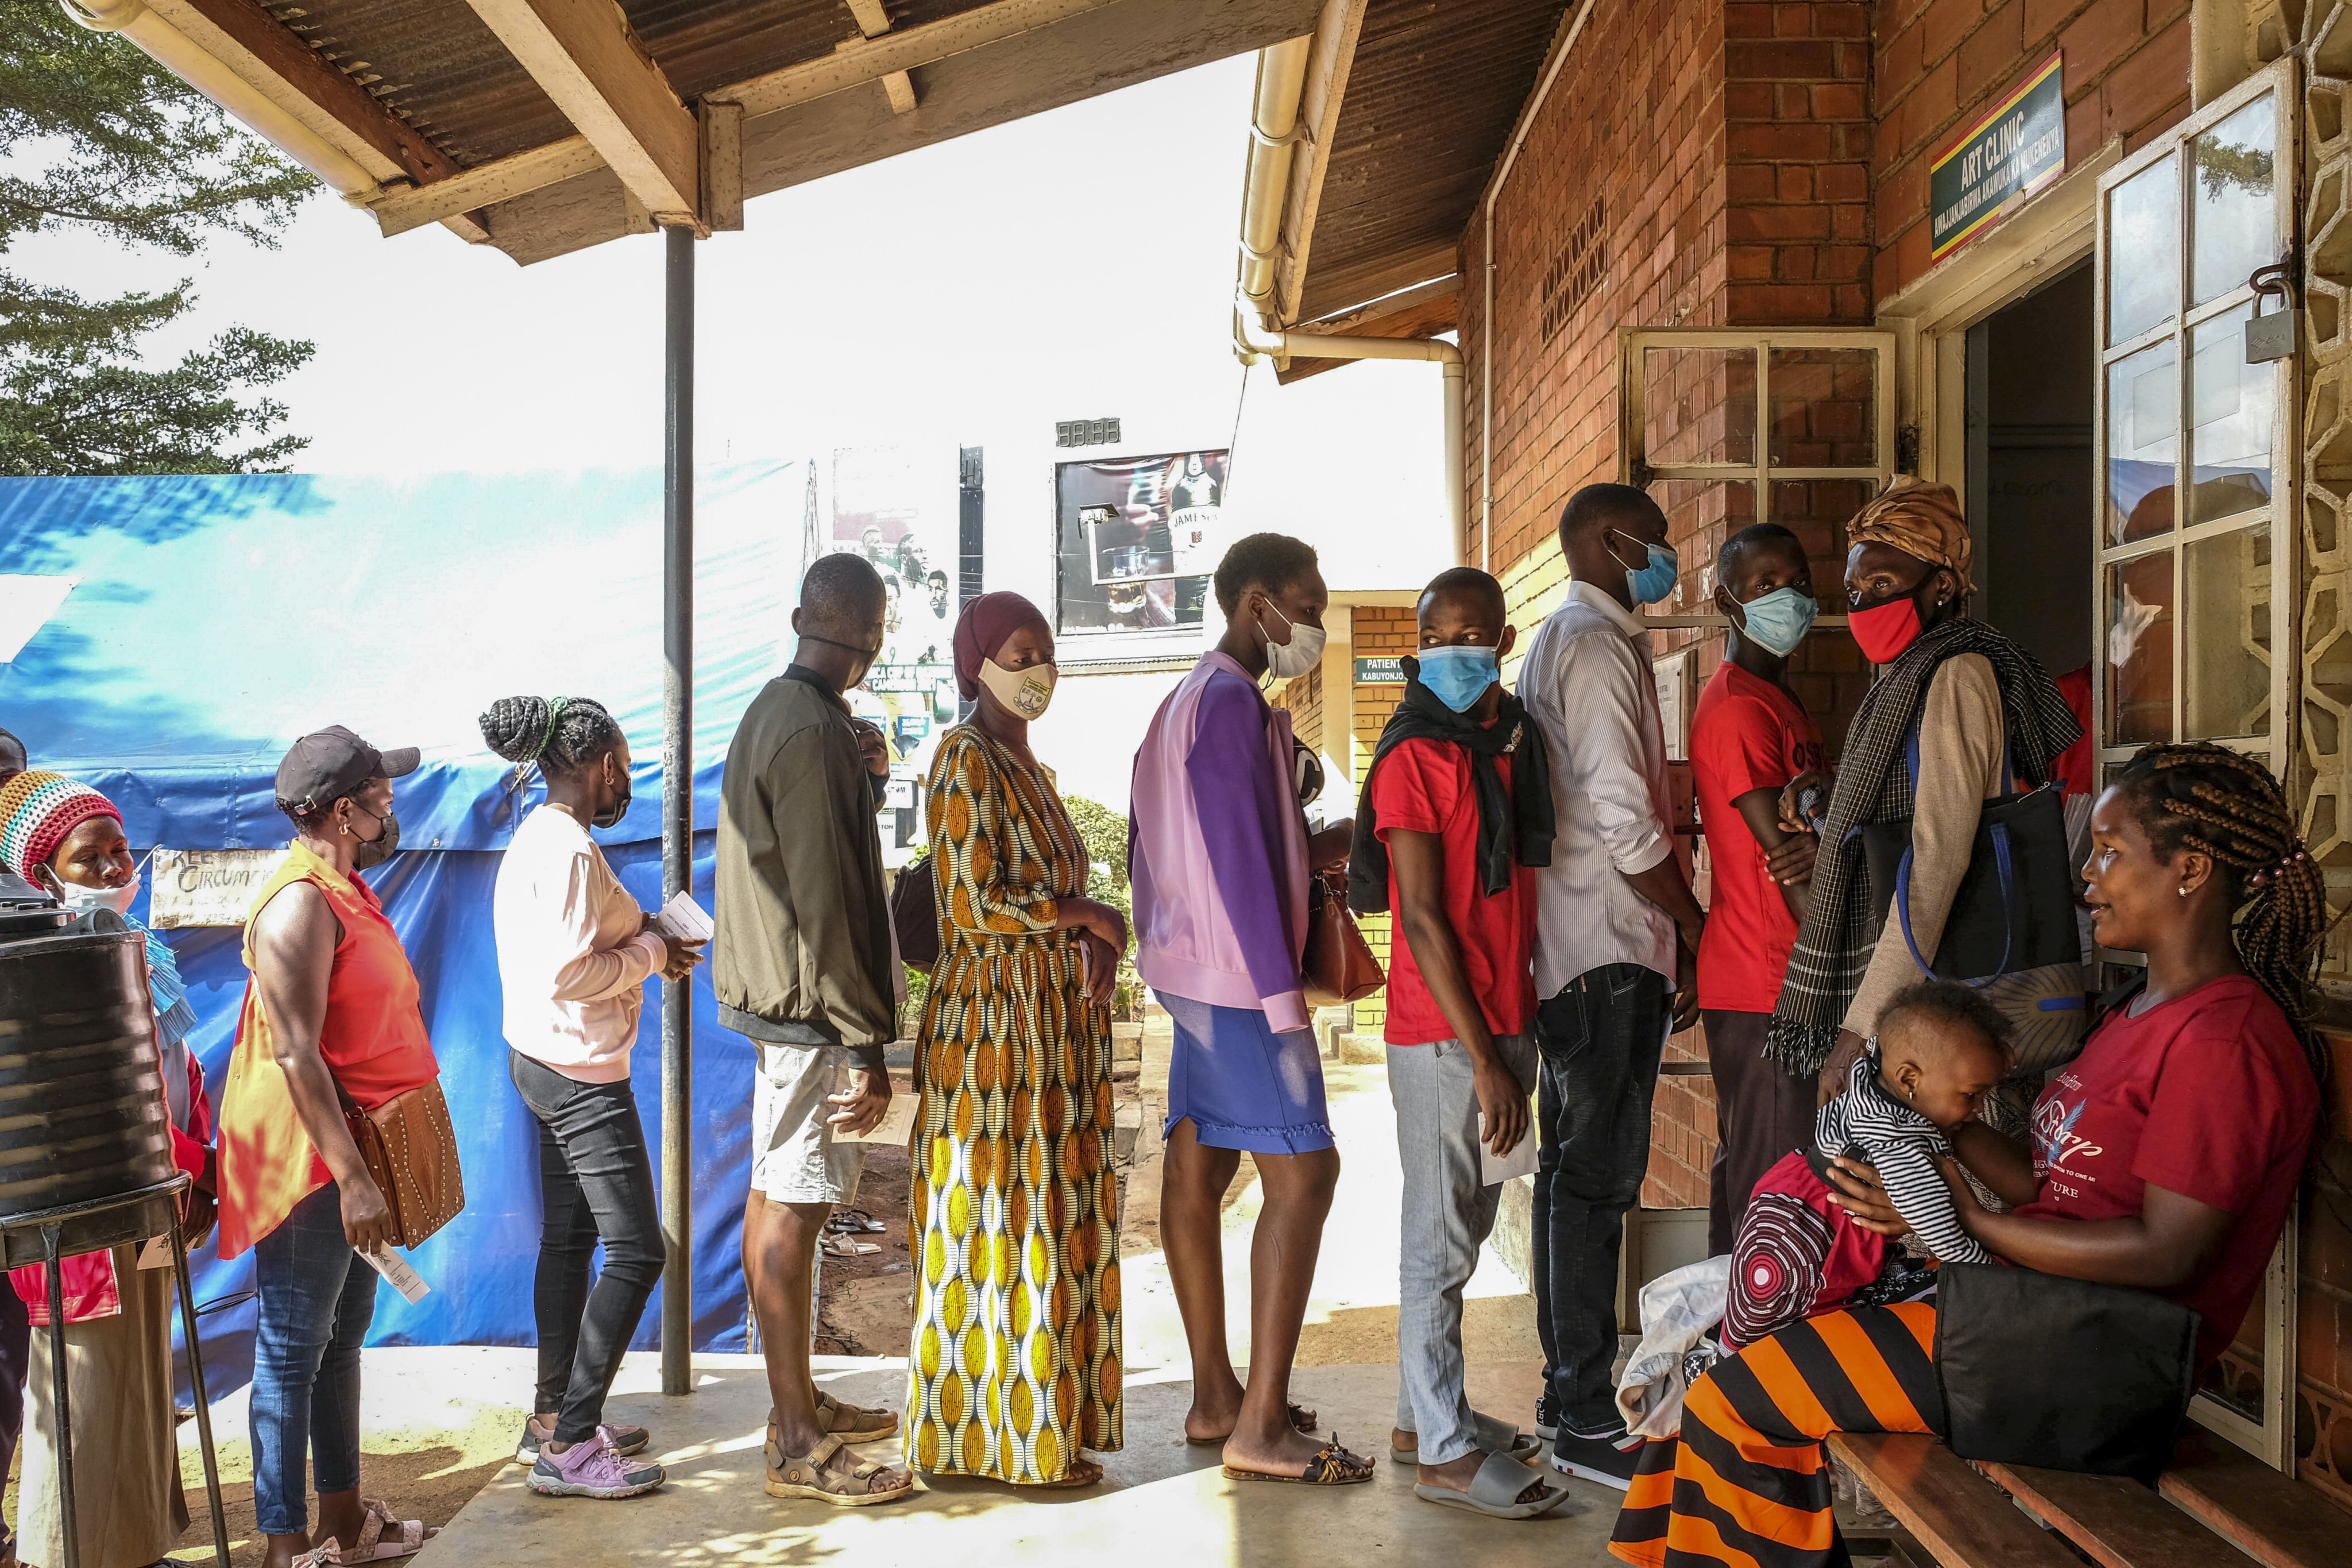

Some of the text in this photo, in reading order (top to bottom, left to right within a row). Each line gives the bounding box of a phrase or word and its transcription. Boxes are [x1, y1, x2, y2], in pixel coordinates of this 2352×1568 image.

[1961, 111, 2025, 192] ART CLINIC
[1362, 672, 1404, 680] KABUYONJO
[172, 850, 214, 868] REE
